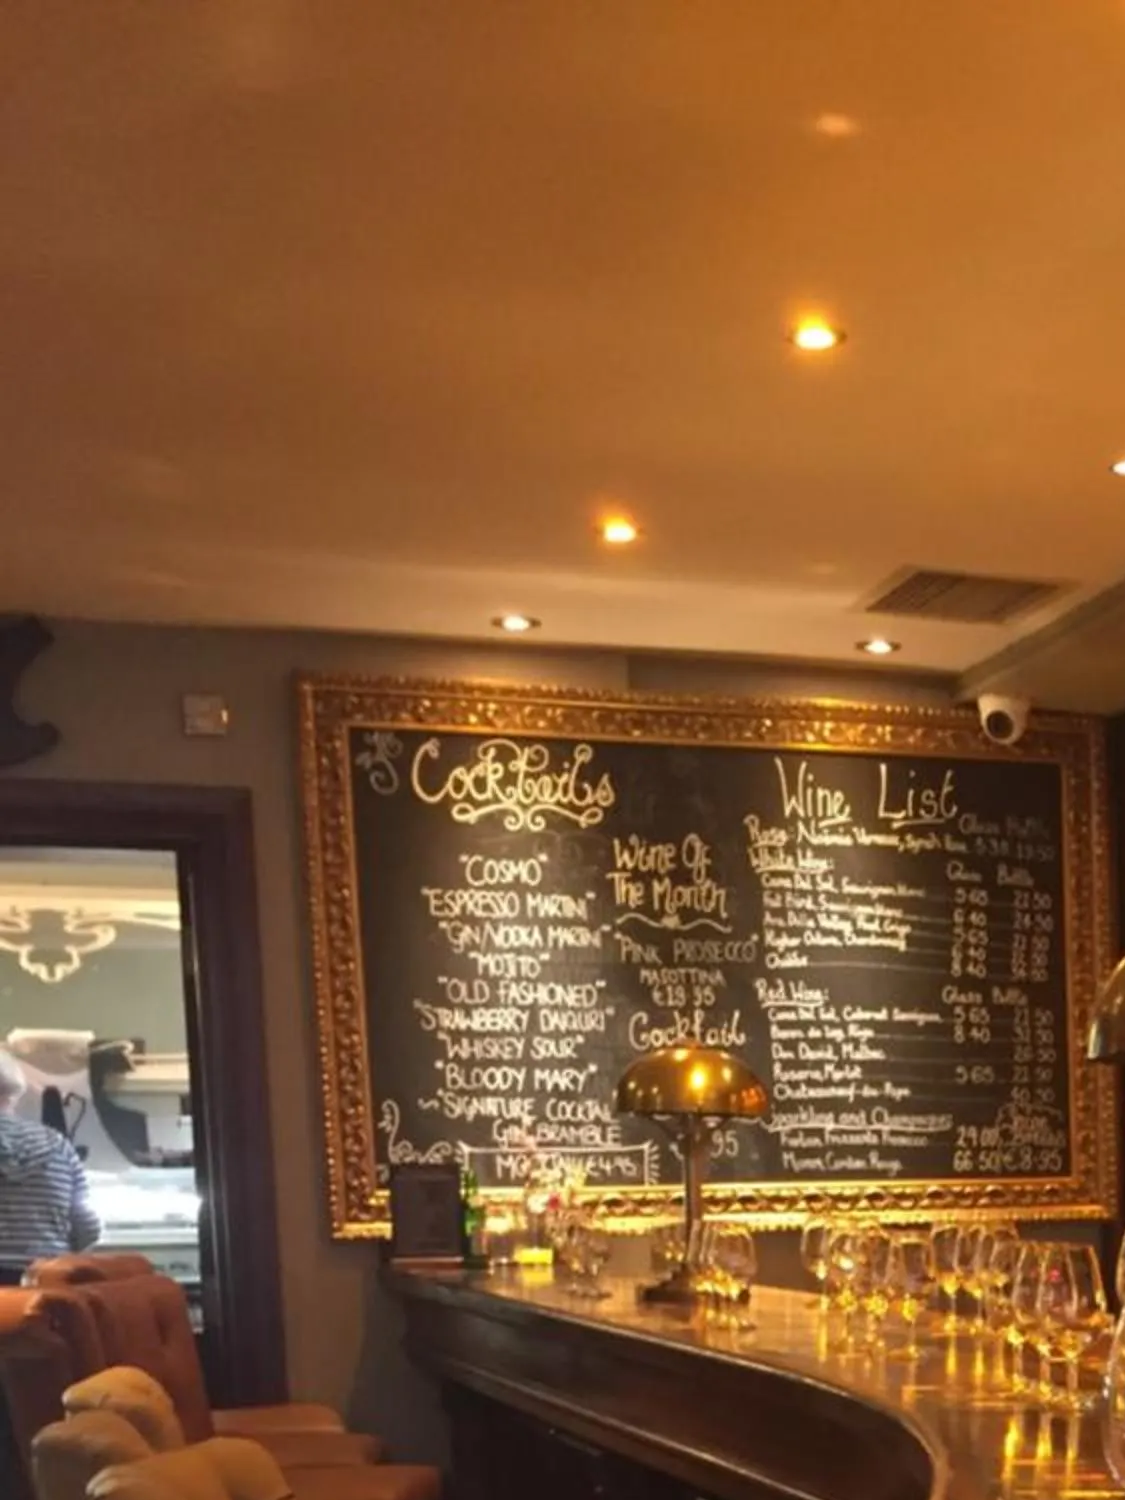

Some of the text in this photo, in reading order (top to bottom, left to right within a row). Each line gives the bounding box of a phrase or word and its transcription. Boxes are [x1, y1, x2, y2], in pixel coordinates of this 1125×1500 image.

[775, 757, 958, 820] Wine List
[613, 834, 675, 873] Wine
[606, 871, 729, 918] The Month
